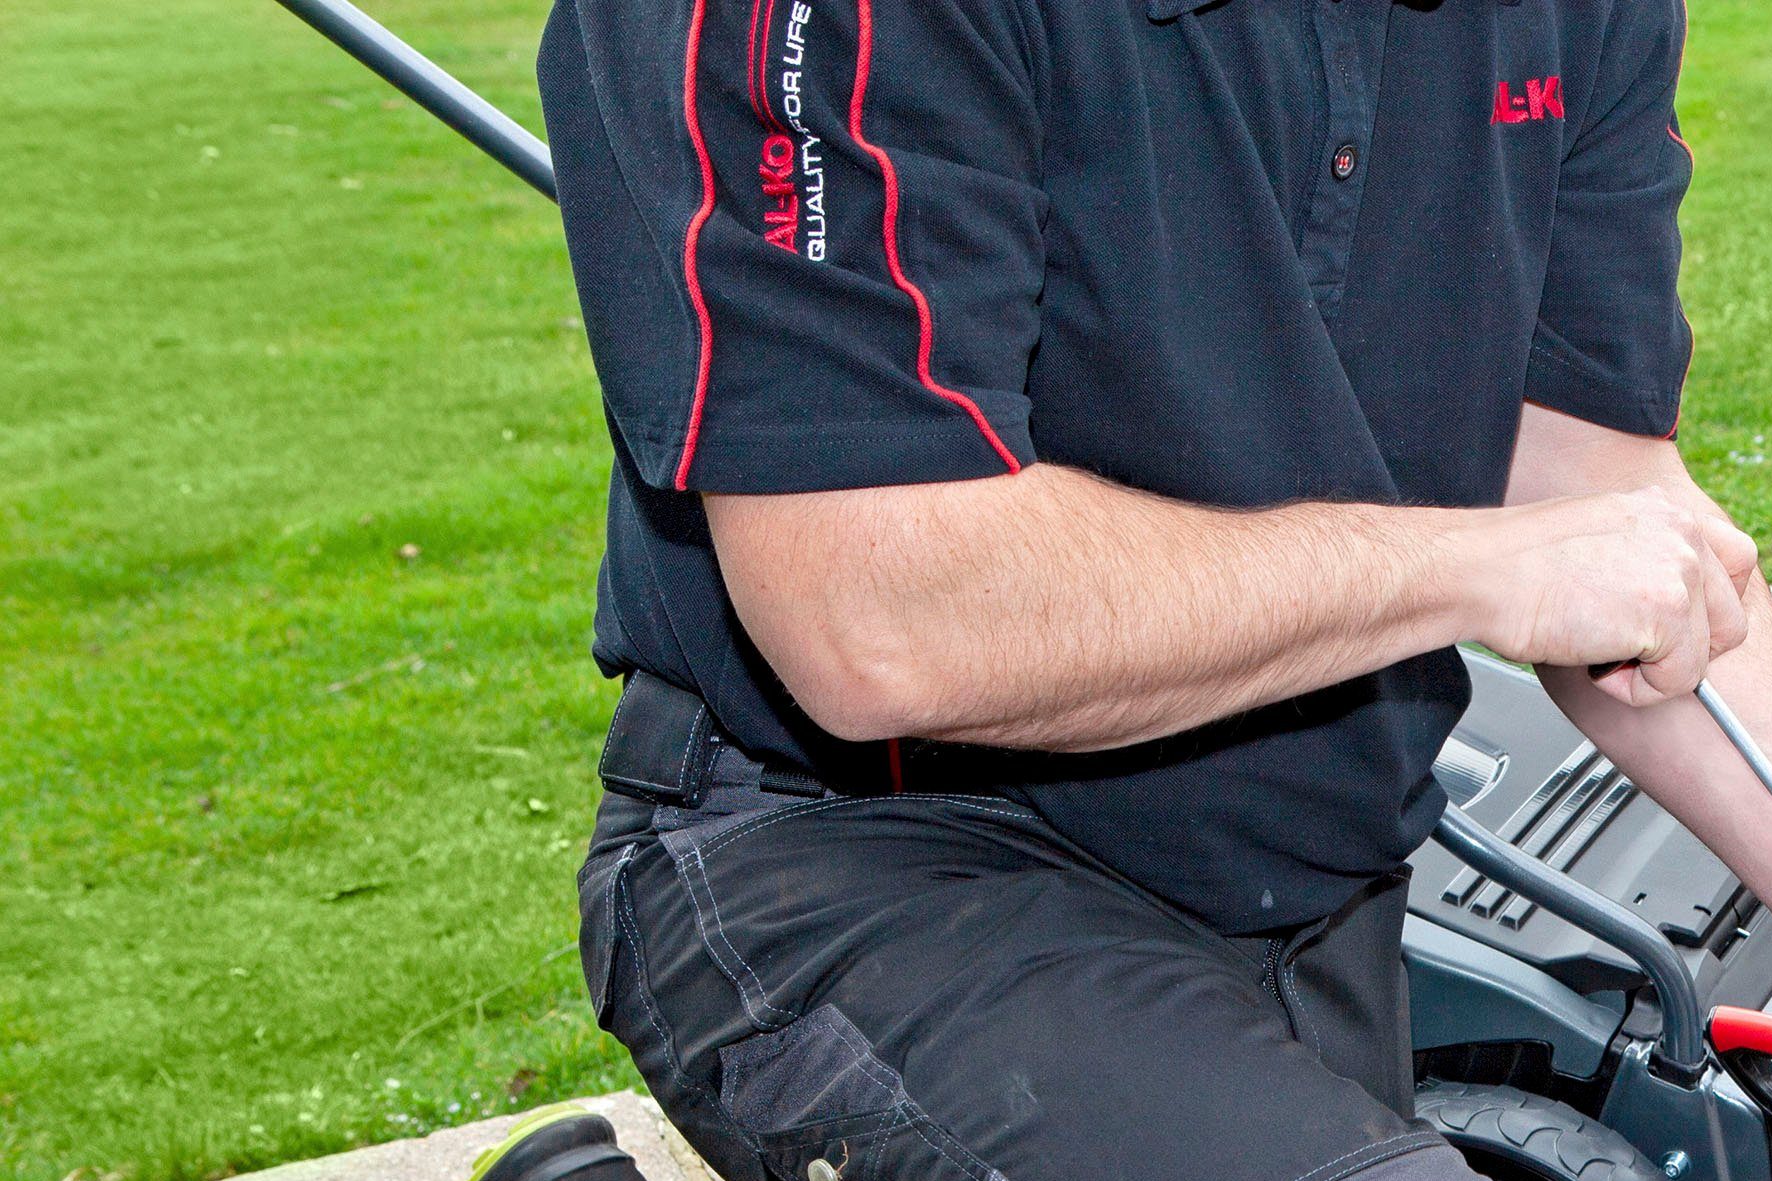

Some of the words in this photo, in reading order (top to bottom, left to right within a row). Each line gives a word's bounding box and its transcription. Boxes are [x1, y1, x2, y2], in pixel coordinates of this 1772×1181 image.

[783, 1, 811, 65] LIFE
[1490, 74, 1565, 126] L-K
[759, 134, 798, 254] AL-KO
[802, 135, 826, 261] QUALITY
